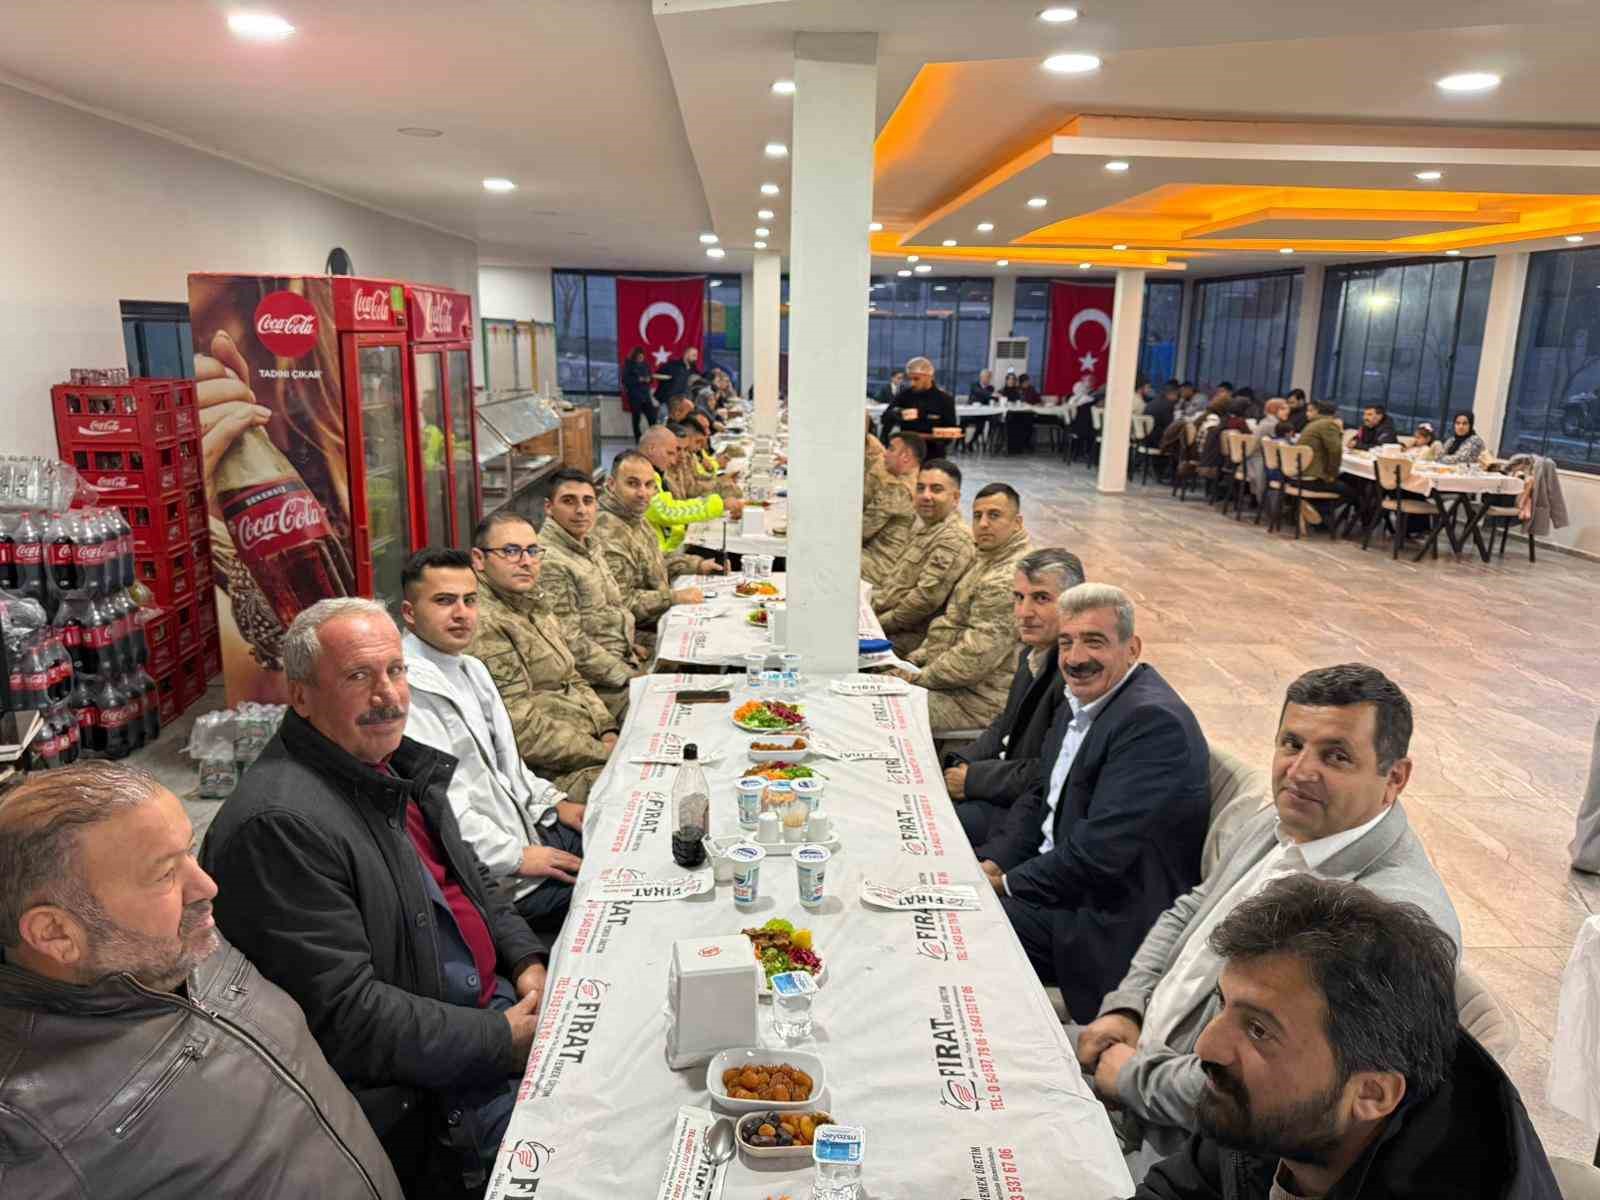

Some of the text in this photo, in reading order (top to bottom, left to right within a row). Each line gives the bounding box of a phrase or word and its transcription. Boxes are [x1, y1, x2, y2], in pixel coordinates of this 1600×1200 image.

[257, 313, 316, 335] Coca-Cola
[238, 497, 321, 551] Coca-Cola
[640, 799, 664, 834] FIRAT
[897, 810, 919, 841] FIRAT
[558, 1002, 601, 1064] FIRAT
[931, 1018, 965, 1077] FIRAT
[998, 1147, 1014, 1160] 06
[1001, 1161, 1018, 1173] 67
[1005, 1175, 1024, 1193] 537
